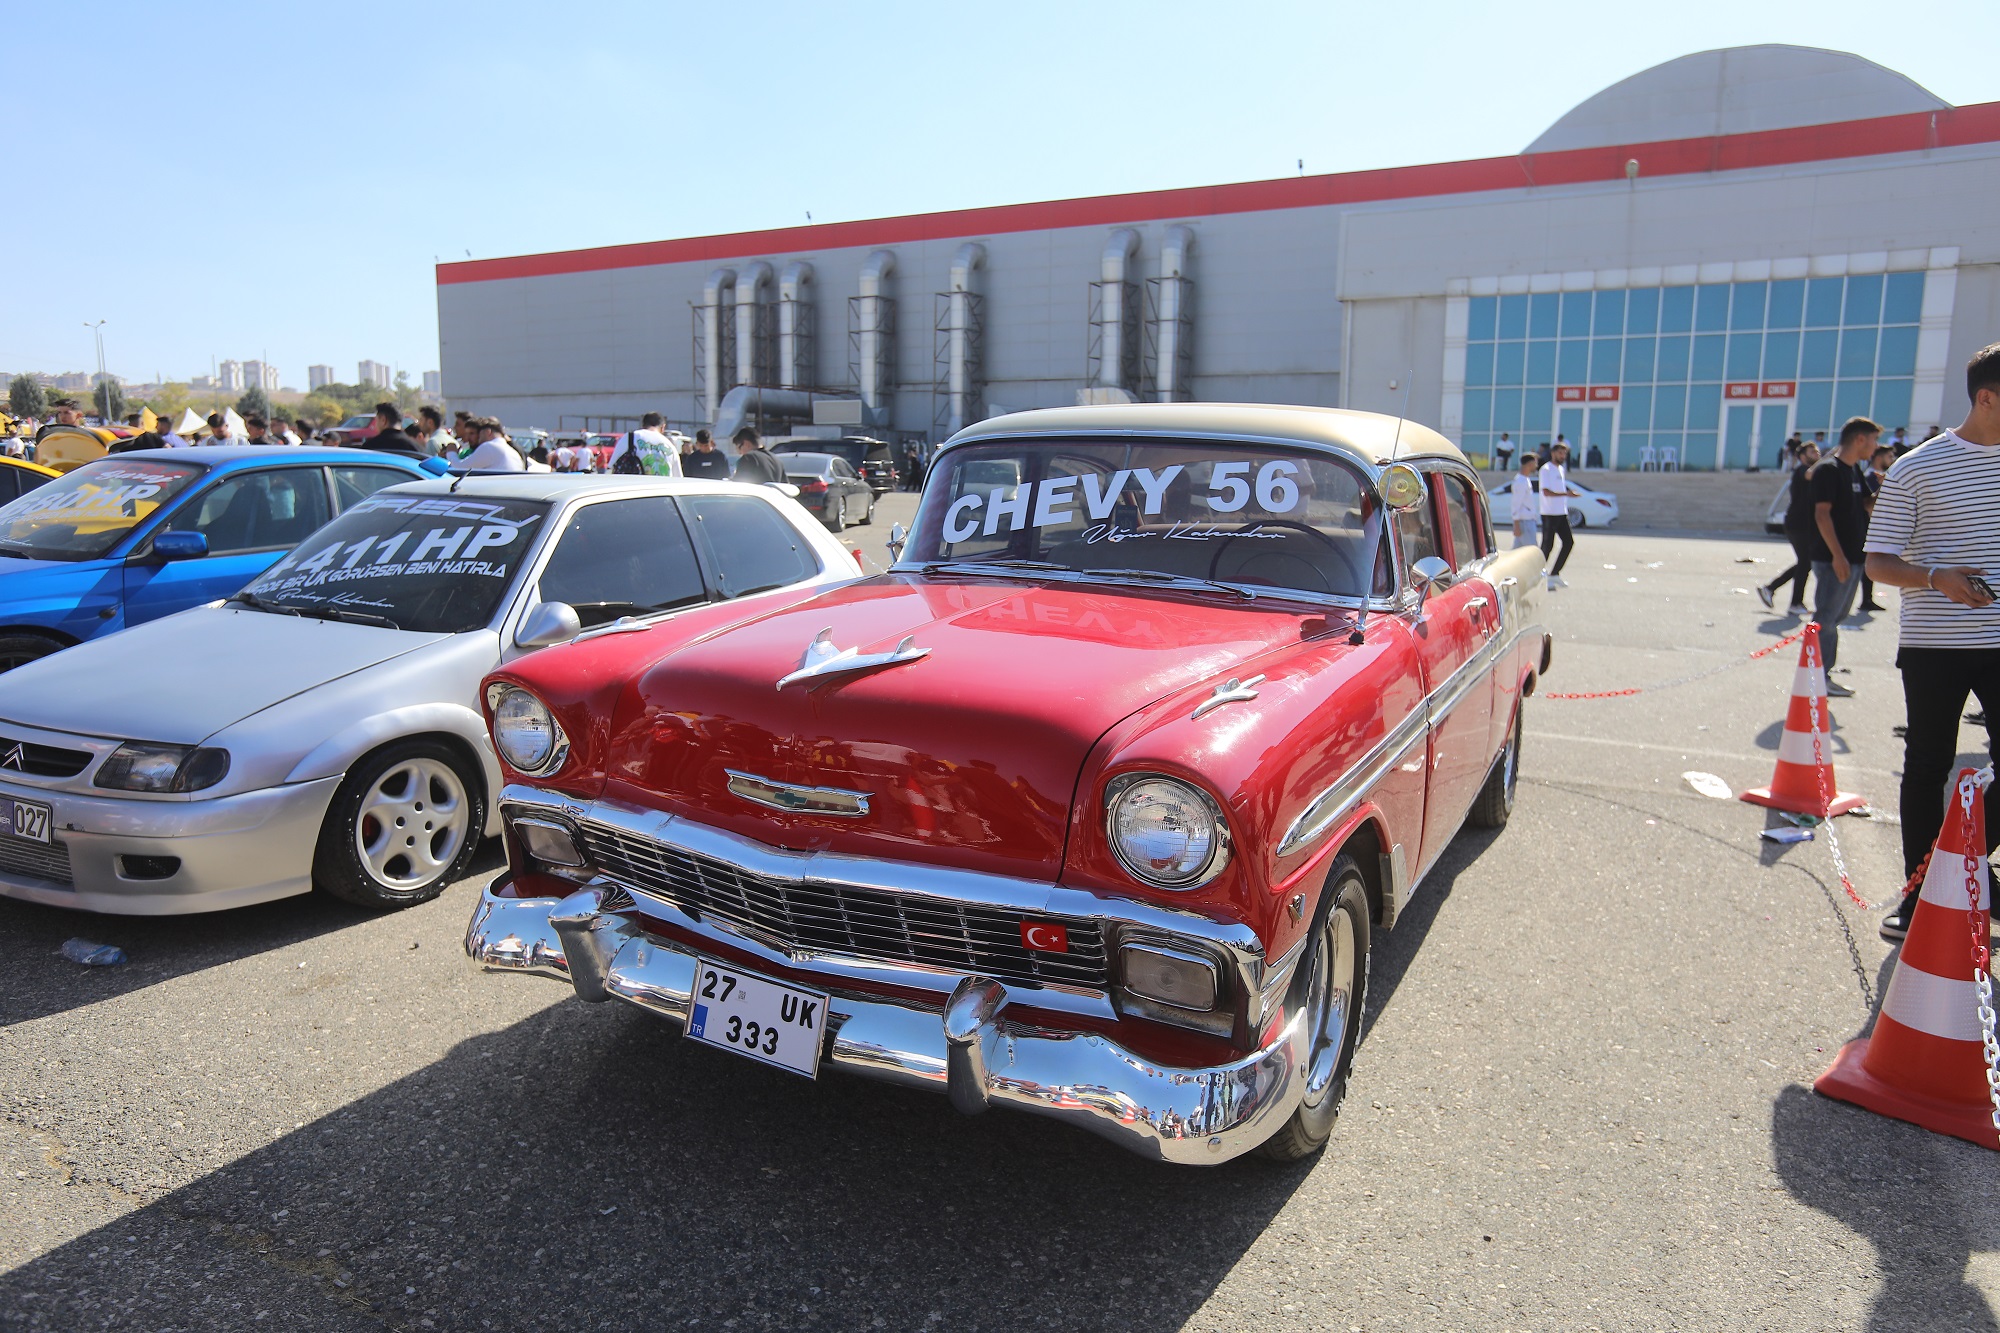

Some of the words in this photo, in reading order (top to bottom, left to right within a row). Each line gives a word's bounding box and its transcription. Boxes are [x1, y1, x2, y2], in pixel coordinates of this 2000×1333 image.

[75, 484, 162, 508] HP
[942, 464, 1185, 544] CHEVY
[1206, 460, 1299, 513] 56
[407, 525, 519, 562] HP
[1081, 523, 1157, 545] Uğur
[1163, 519, 1286, 541] Kalender
[303, 569, 335, 588] UK
[439, 560, 506, 578] HATIRLA
[14, 804, 48, 838] 027
[702, 970, 737, 1002] 27
[781, 993, 817, 1029] UK
[692, 1023, 703, 1035] TR
[725, 1015, 779, 1055] 333
